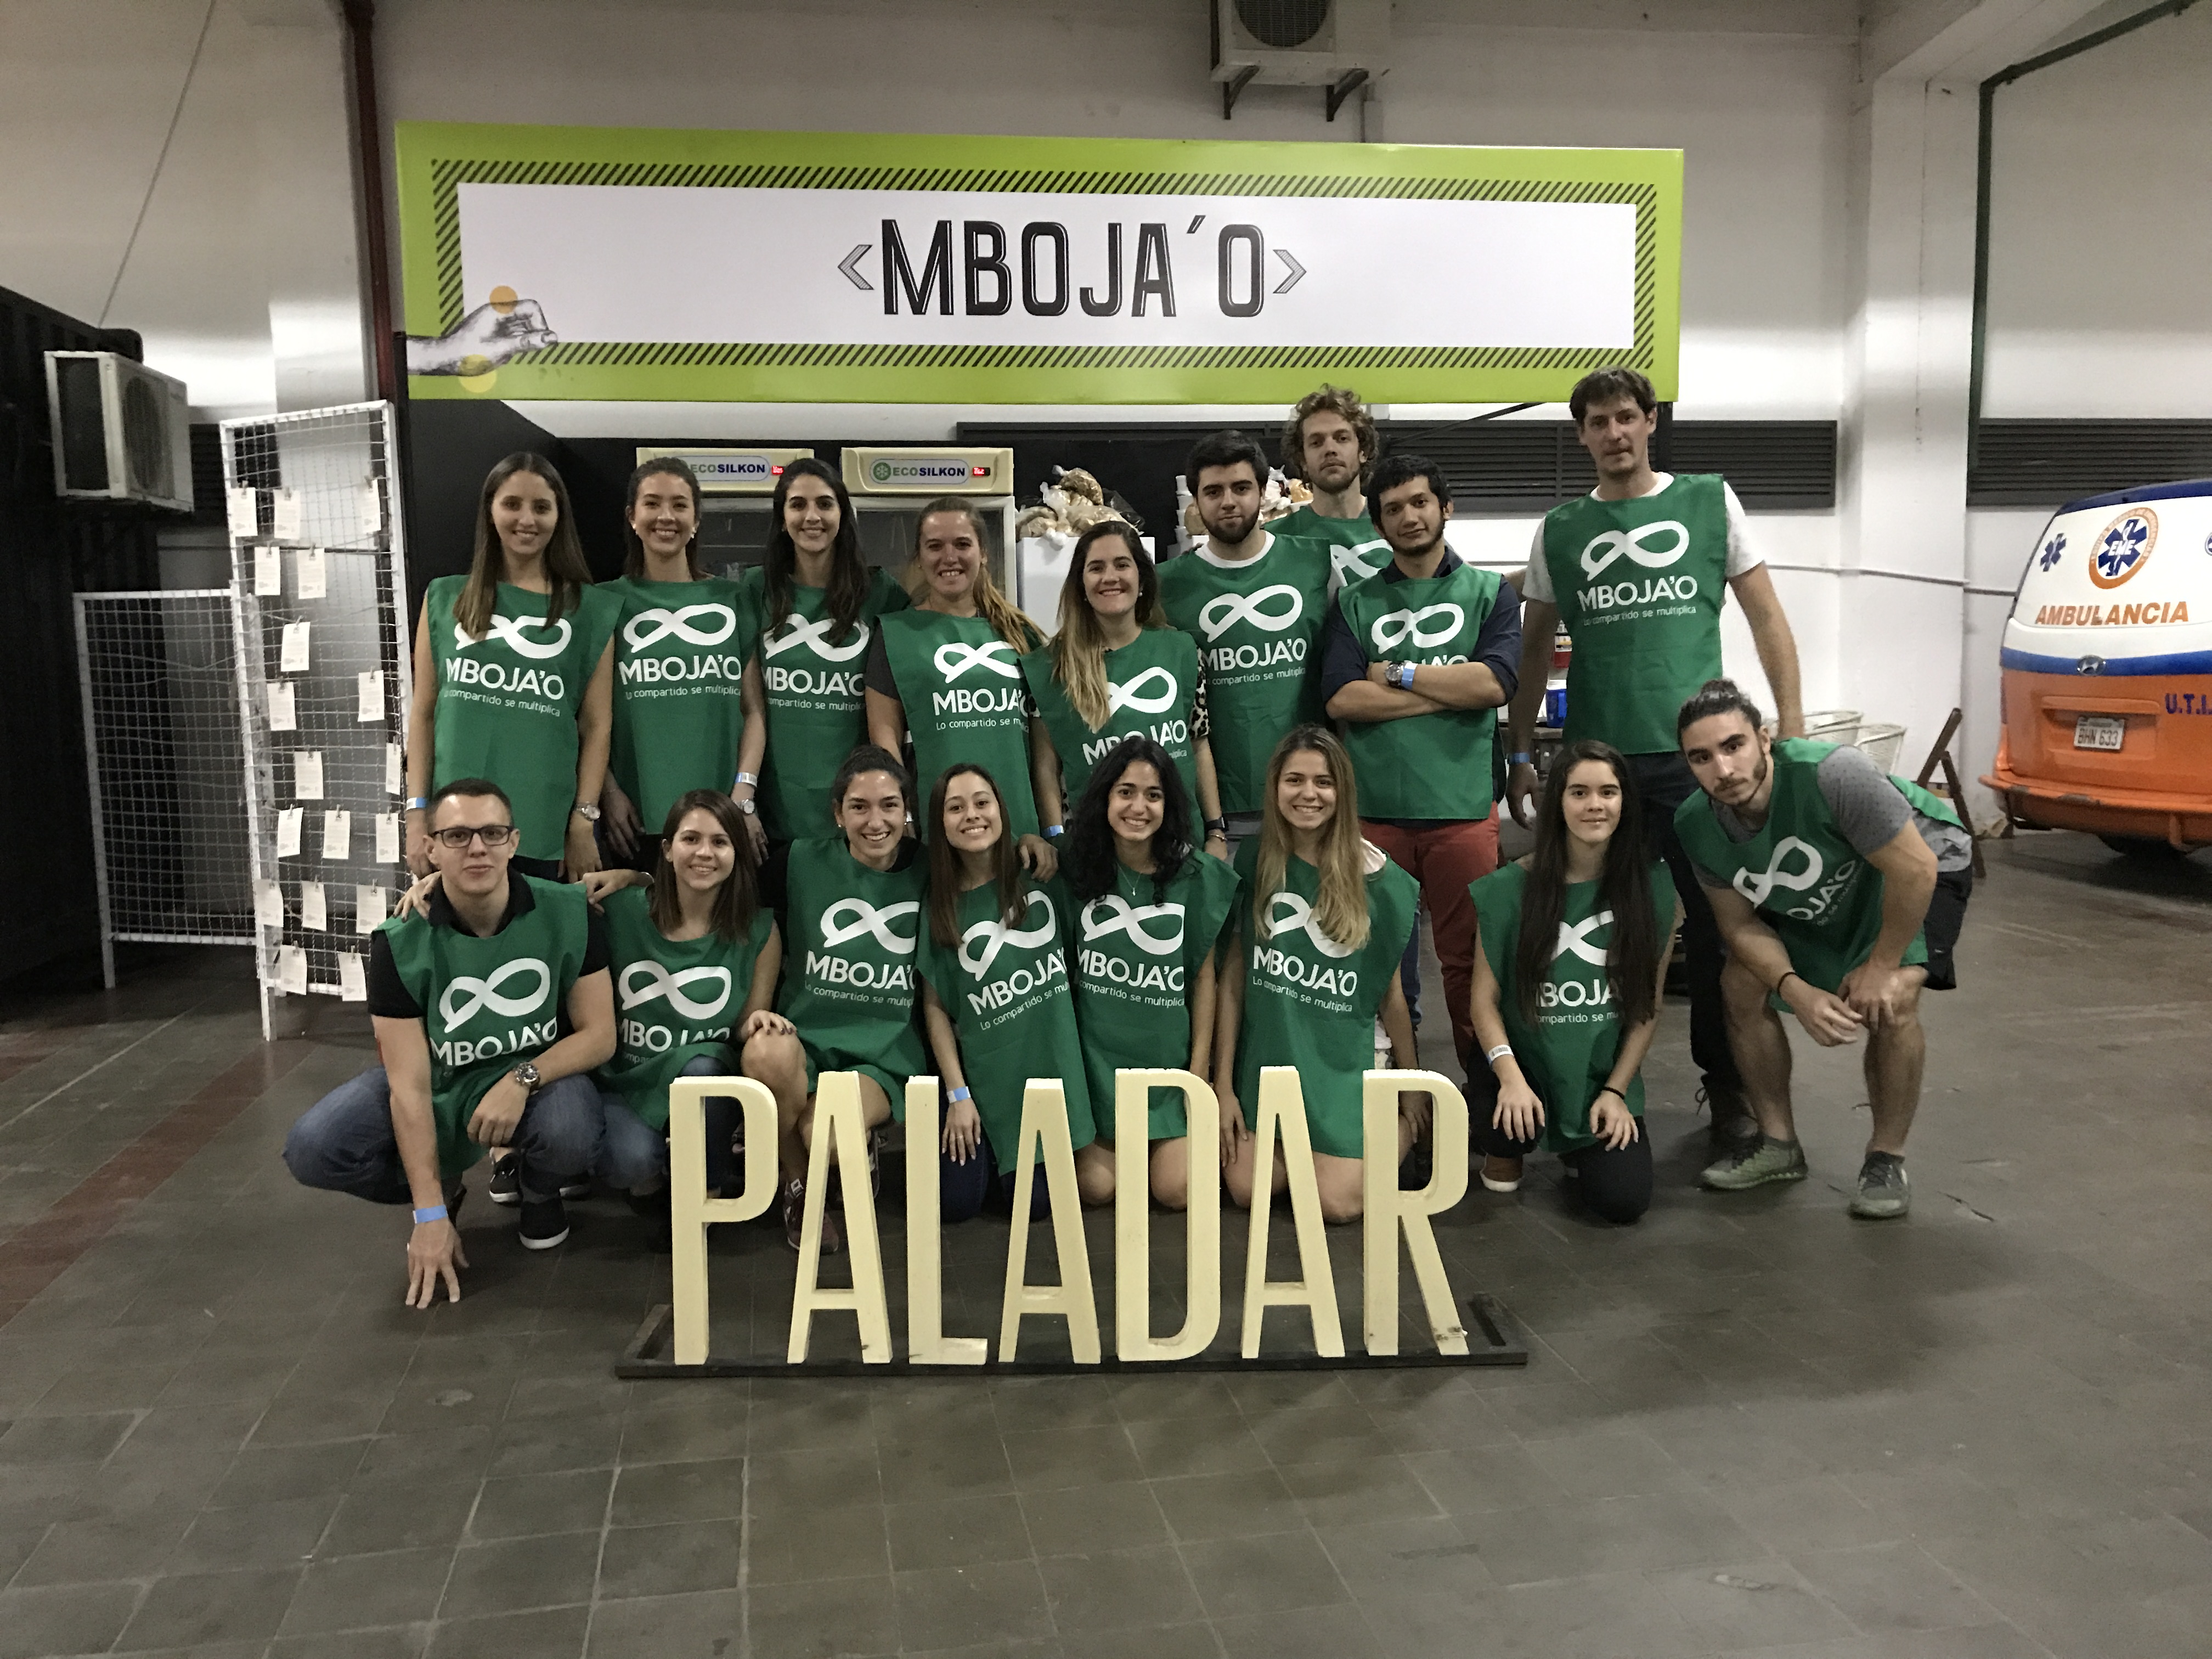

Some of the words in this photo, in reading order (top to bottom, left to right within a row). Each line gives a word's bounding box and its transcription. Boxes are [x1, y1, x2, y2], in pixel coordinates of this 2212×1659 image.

[892, 467, 966, 476] ECOSILKON
[2108, 539, 2137, 556] EME
[1576, 575, 1698, 612] MBOJA'O
[1642, 610, 1654, 618] se
[1656, 605, 1696, 617] multiplica
[2034, 601, 2188, 626] AMBULANCIA
[445, 657, 565, 700] MBOJA'O
[618, 654, 742, 685] MBOJA'O
[1211, 673, 1260, 686] compartido
[1263, 672, 1274, 680] se
[634, 686, 689, 699] compartido
[691, 686, 702, 695] se
[504, 698, 516, 707] se
[518, 700, 561, 717] multiplica
[815, 701, 826, 709] se
[936, 721, 946, 730] Lo
[949, 718, 997, 729] compartido
[1000, 718, 1011, 726] se
[2098, 730, 2119, 746] 633
[967, 946, 1068, 1015] MBOJA'
[1253, 945, 1357, 997] MBOJA'O
[814, 987, 870, 1003] compartido
[872, 995, 884, 1003] se
[1079, 979, 1127, 1000] compartido
[1130, 994, 1142, 1003] se
[1252, 976, 1262, 986] Lo
[1300, 994, 1312, 1003] se
[1314, 998, 1352, 1013] multiplica
[980, 1022, 991, 1031] Lo
[993, 995, 1042, 1025] compartido
[1043, 989, 1053, 1000] se
[1538, 1012, 1588, 1025] ompartido
[1592, 1013, 1604, 1022] se
[429, 1015, 557, 1066] MBOJA'O
[669, 1066, 1470, 1365] PALADAR
